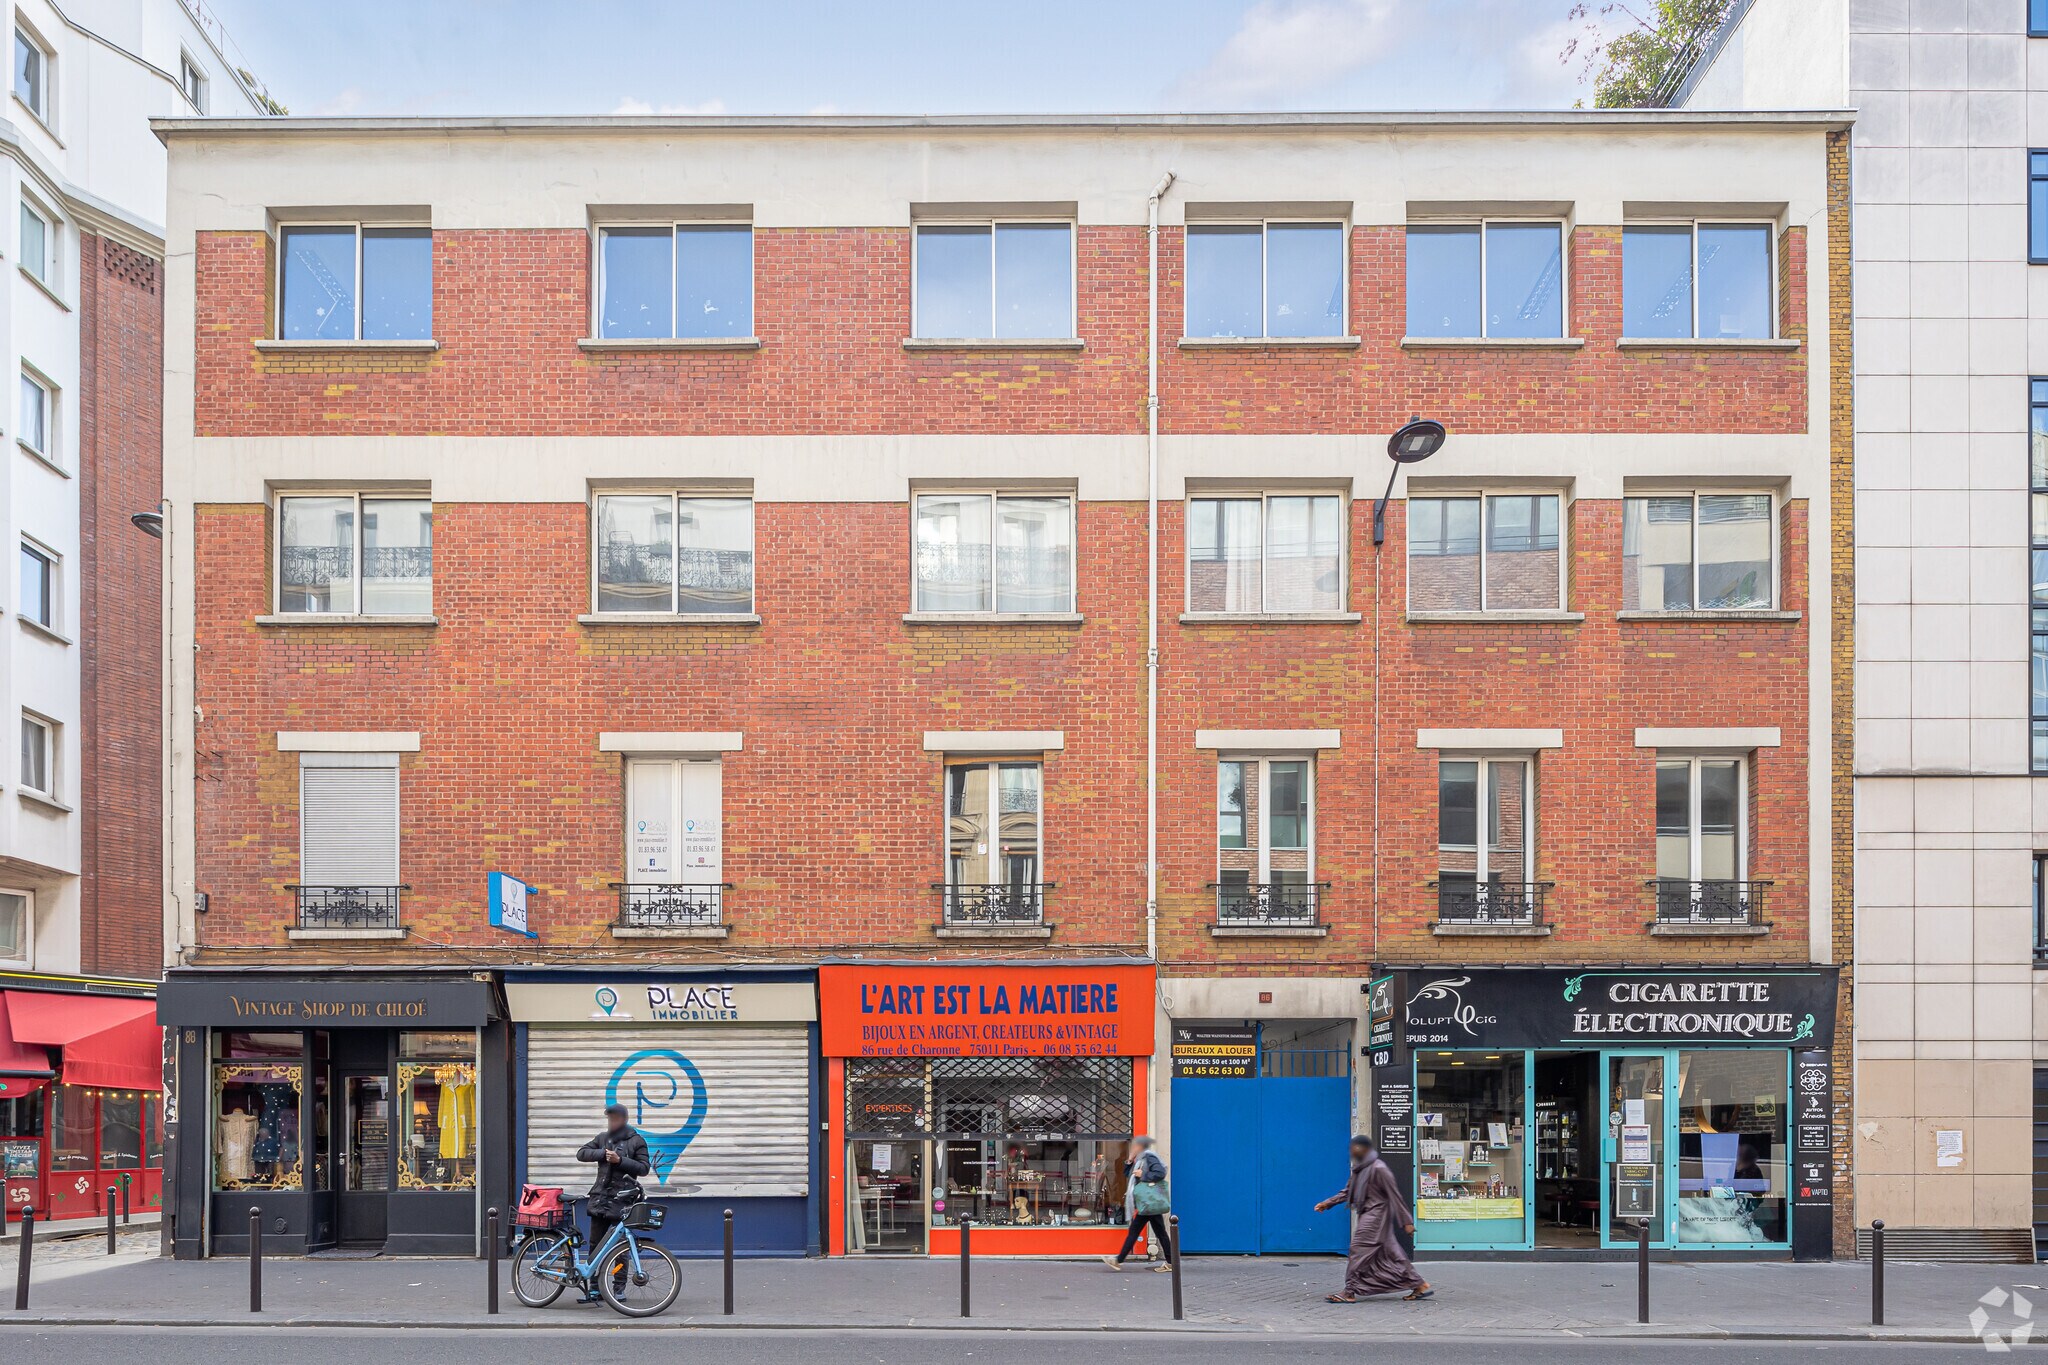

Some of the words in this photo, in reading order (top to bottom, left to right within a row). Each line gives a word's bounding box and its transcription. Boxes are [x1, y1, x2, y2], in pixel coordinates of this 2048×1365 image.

[647, 987, 737, 1009] PLACE
[861, 984, 925, 1014] L'ART
[933, 985, 970, 1014] EST
[979, 985, 1011, 1014] LA
[1019, 983, 1118, 1014] MATIERE
[1609, 983, 1770, 1003] CIGARETTE
[652, 1010, 738, 1020] IMMOBILIER
[1572, 1007, 1793, 1037] ÉLECTRONIQUE
[862, 1026, 906, 1043] BIJOUX
[909, 1025, 925, 1040] EN
[928, 1025, 980, 1041] ARGENT,
[982, 1025, 1053, 1040] CREATEURS
[861, 1045, 874, 1055] 86
[877, 1046, 893, 1055] rue
[896, 1044, 908, 1055] de
[911, 1044, 960, 1055] Charonne
[970, 1044, 999, 1055] 75011
[1003, 1044, 1029, 1055] Paris
[1043, 1044, 1056, 1055] 06
[1059, 1044, 1071, 1055] 08
[1075, 1044, 1086, 1055] 35
[1089, 1044, 1102, 1055] 62
[1105, 1044, 1117, 1054] 44
[1374, 1051, 1389, 1065] CBD
